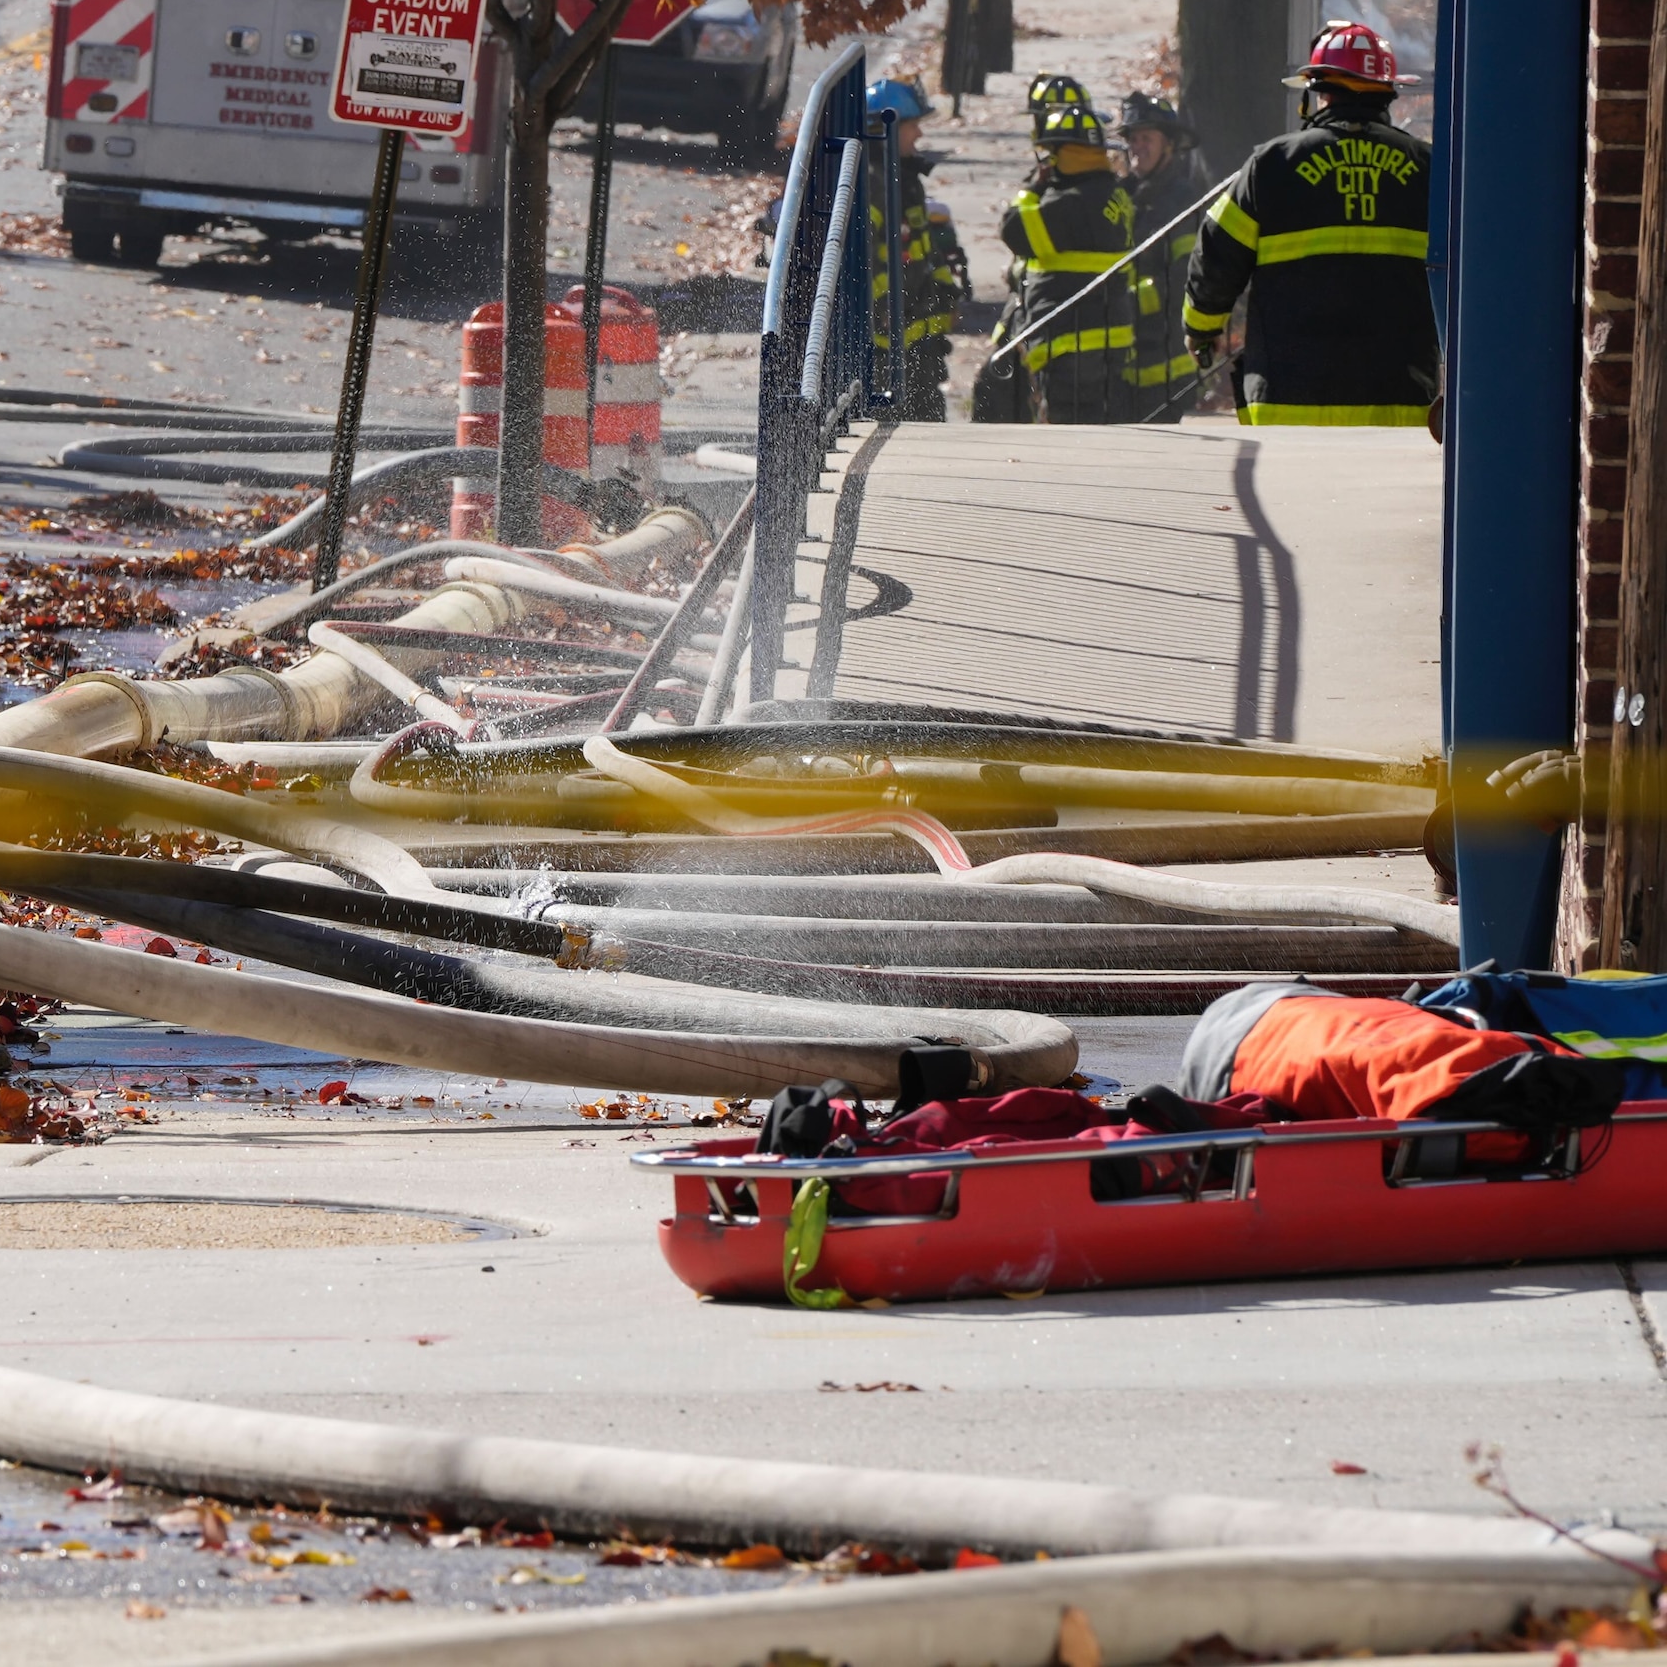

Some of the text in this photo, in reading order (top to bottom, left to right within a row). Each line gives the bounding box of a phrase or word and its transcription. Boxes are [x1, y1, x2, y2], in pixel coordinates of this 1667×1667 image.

[373, 7, 452, 38] EVENT
[387, 50, 442, 62] RAVENS
[1364, 54, 1392, 76] E 6
[209, 63, 329, 85] EMERGENCY
[224, 86, 311, 107] MEDICAL
[219, 108, 314, 130] SERVICES
[346, 101, 454, 126] TOW AWAY ZONE
[1295, 138, 1419, 185] BALTIMORE
[1336, 165, 1382, 194] CITY
[1345, 193, 1377, 221] FD
